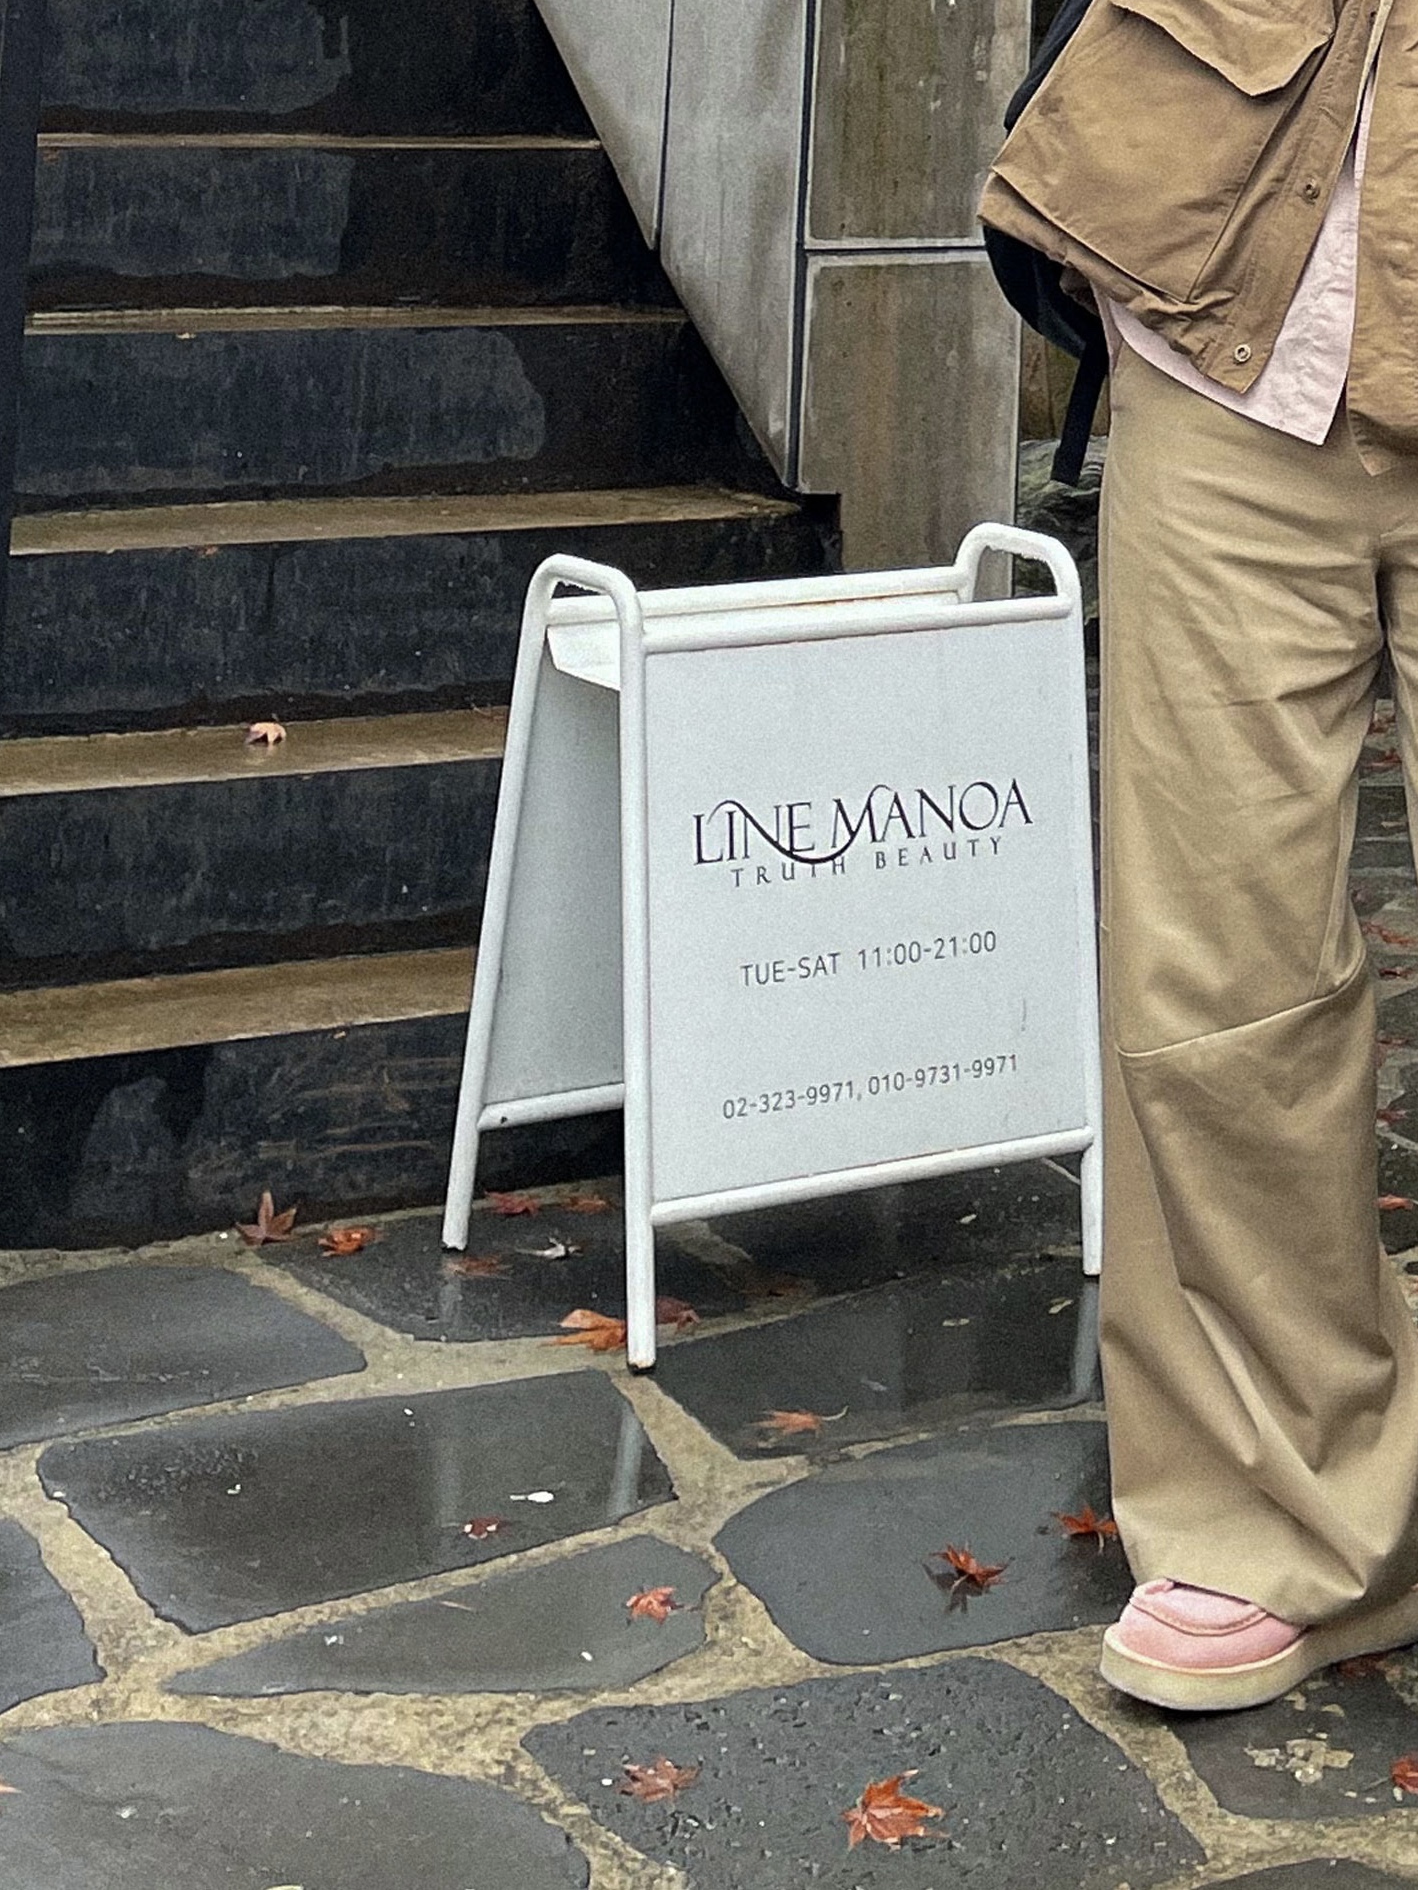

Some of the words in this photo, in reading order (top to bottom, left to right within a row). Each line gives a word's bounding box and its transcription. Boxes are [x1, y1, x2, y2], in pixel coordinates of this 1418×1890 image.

[692, 799, 817, 866] LINE
[830, 777, 1034, 850] MANOA
[730, 857, 847, 888] TRUTH
[875, 835, 1003, 870] BEAUTY
[739, 952, 842, 987] TUE-SAT
[857, 930, 998, 971] 11:00-21:00
[722, 1080, 862, 1120] 02-323-9971,
[867, 1053, 1018, 1096] 010-9731-9971
